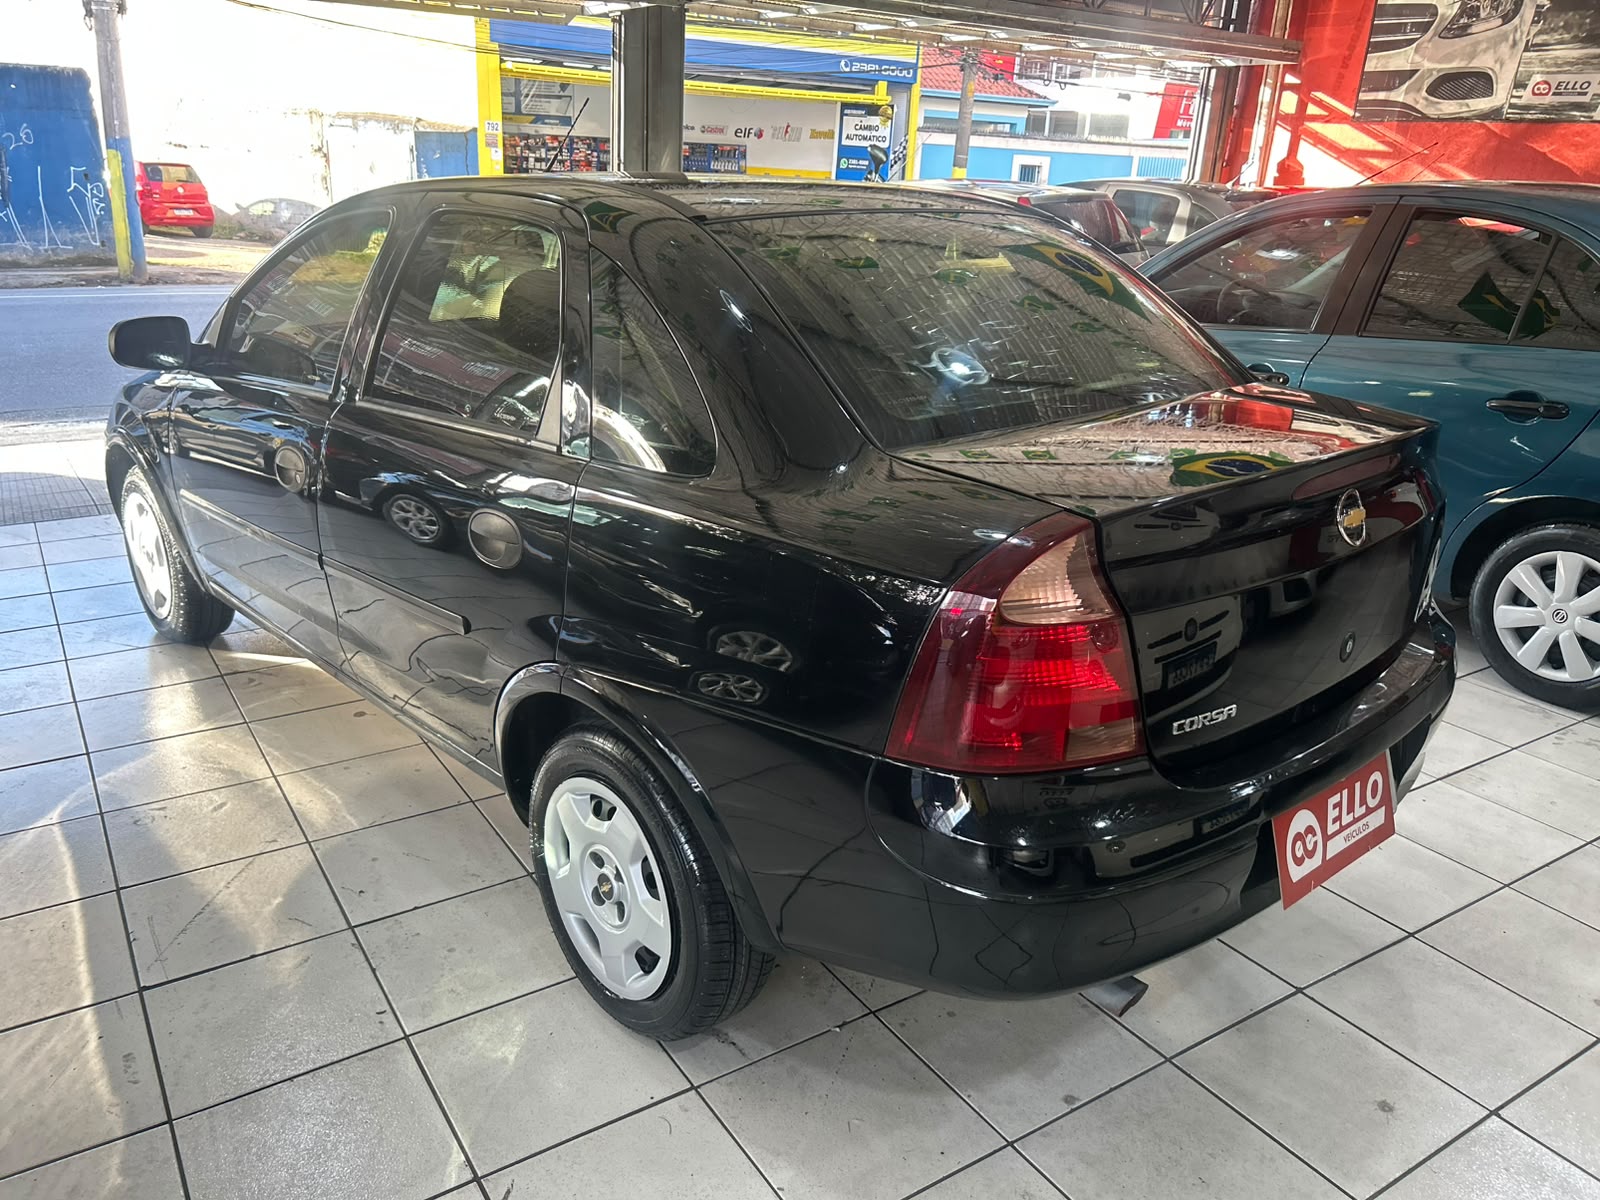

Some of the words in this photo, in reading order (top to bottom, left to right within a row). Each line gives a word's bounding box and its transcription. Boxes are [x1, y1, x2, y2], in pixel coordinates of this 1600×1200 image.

[1555, 80, 1592, 91] ELLO
[486, 121, 500, 132] 792
[854, 120, 880, 132] CÂMBIO
[734, 127, 754, 139] elf
[1172, 703, 1238, 736] CORSA
[1327, 770, 1384, 836] ELLO
